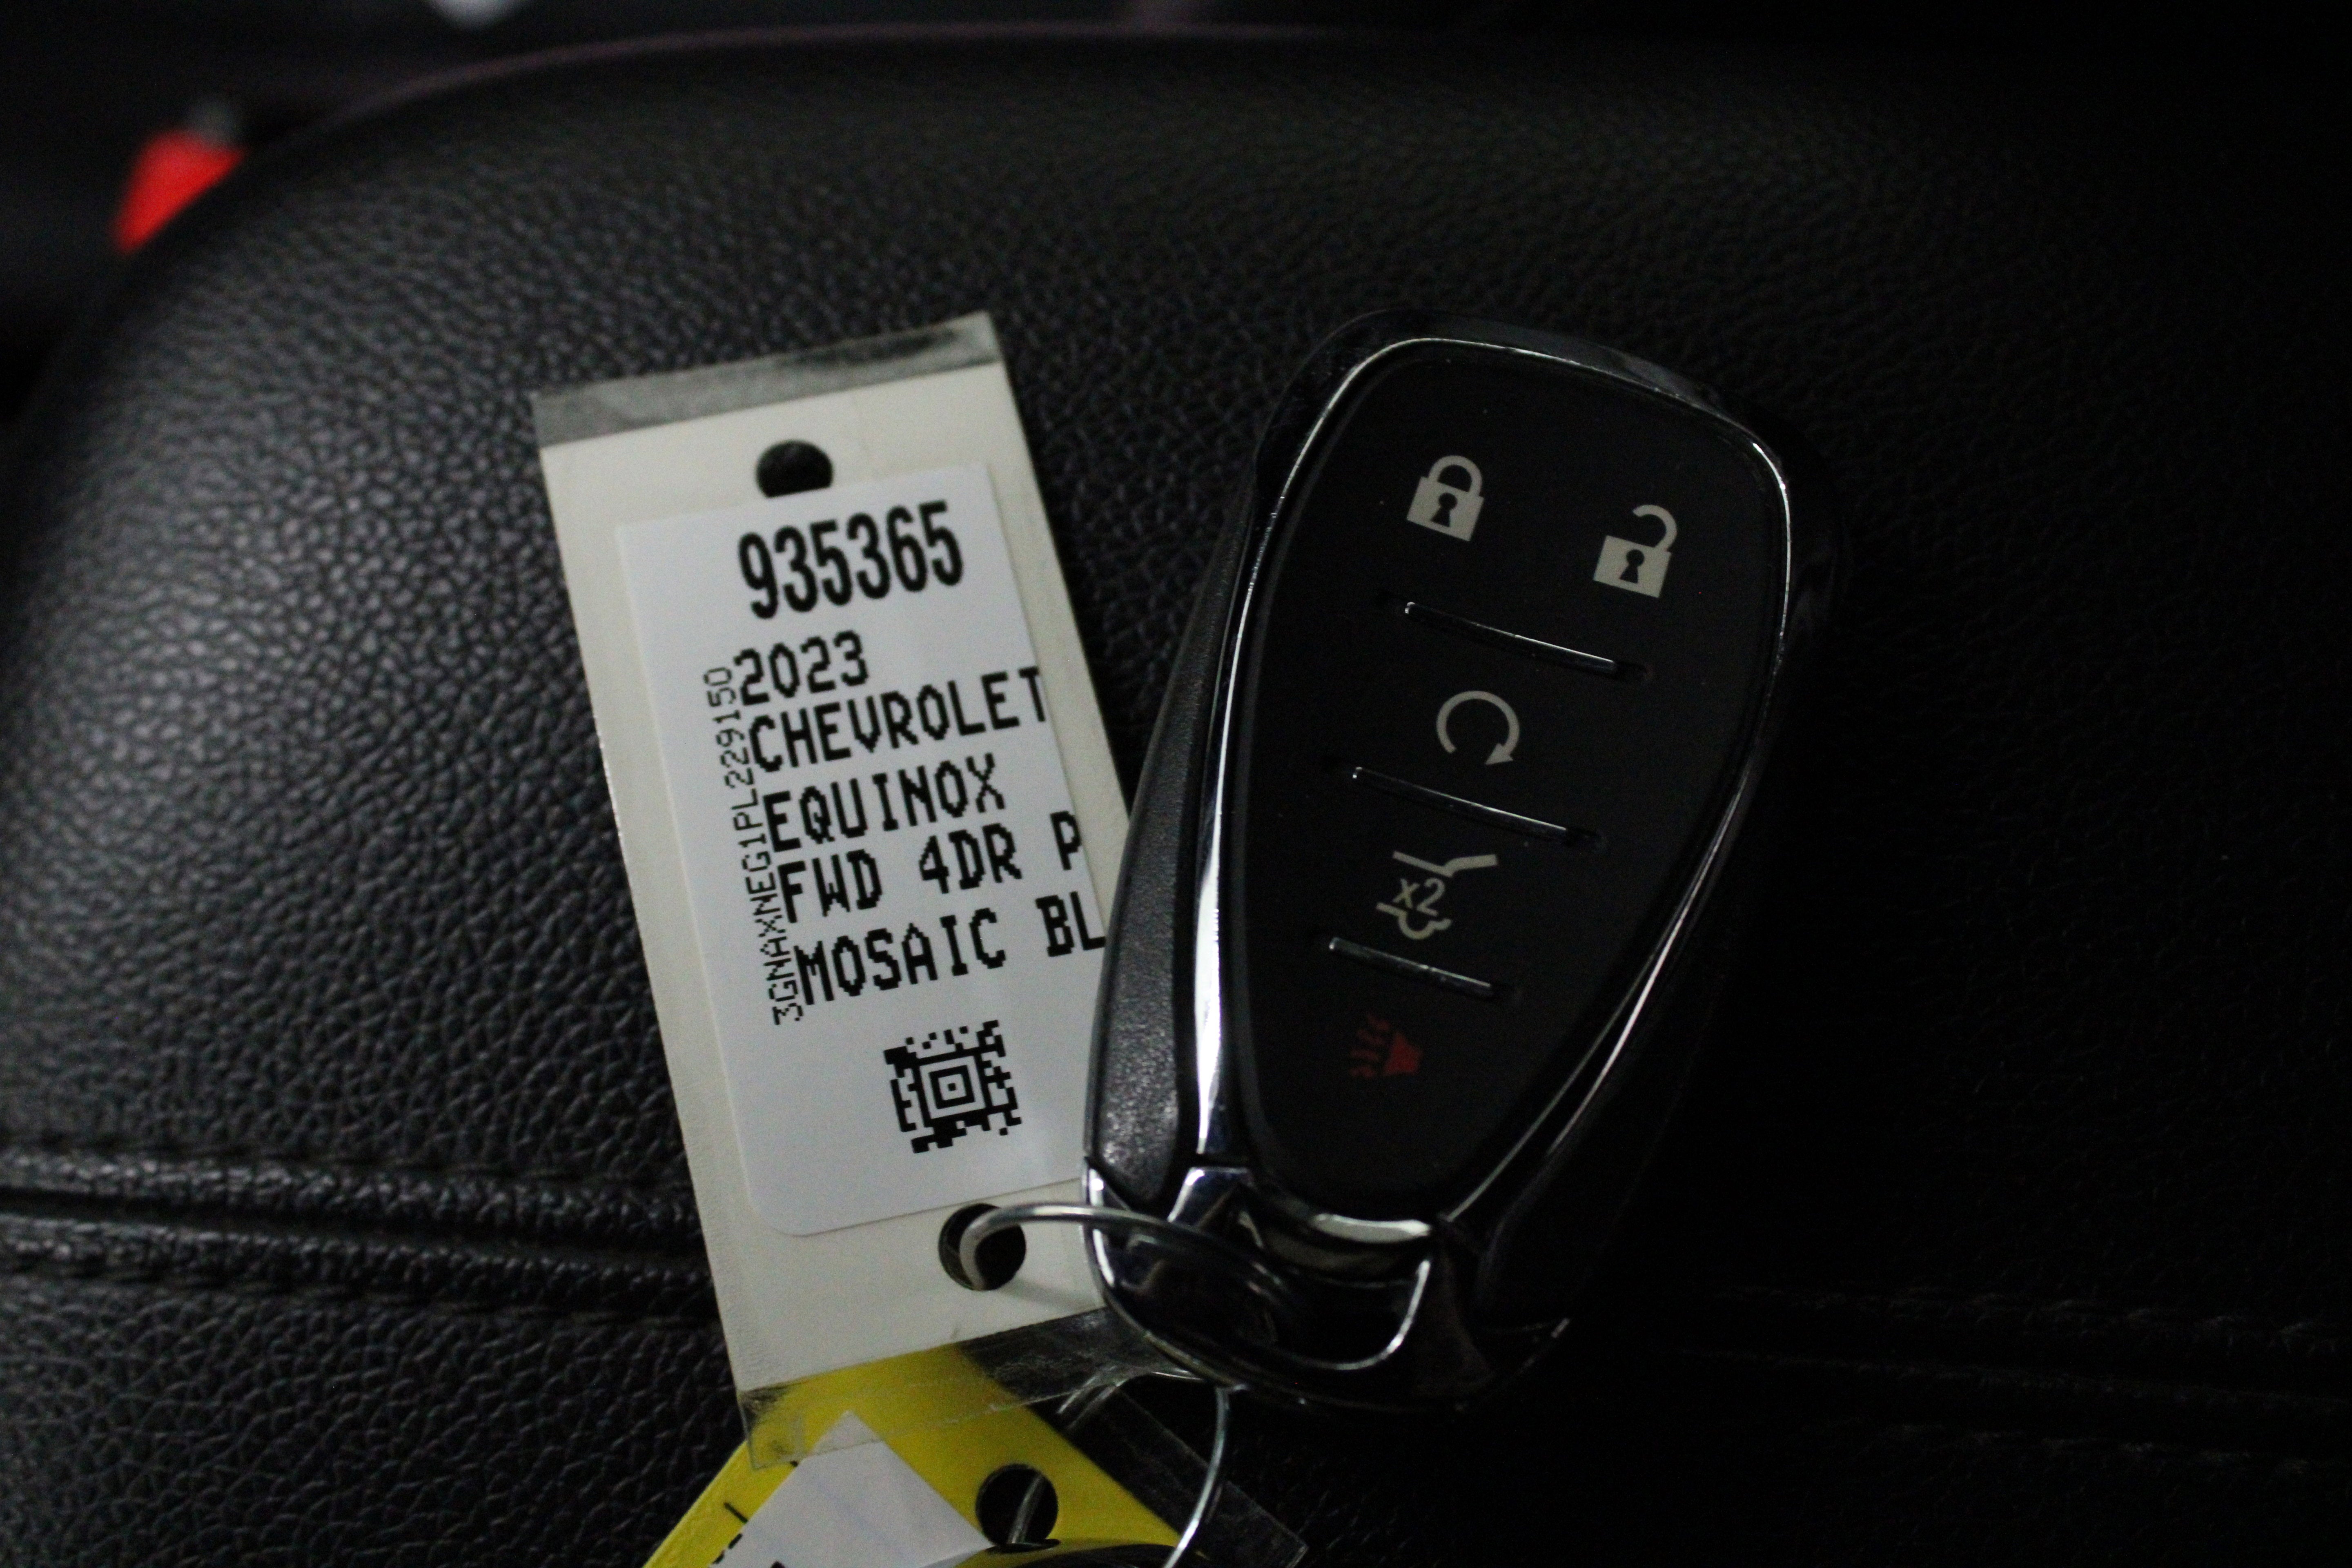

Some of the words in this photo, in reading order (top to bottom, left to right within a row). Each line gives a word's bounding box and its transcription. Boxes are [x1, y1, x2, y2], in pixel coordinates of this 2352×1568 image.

[737, 500, 964, 619] 935365
[734, 630, 869, 706] 2023
[748, 667, 1046, 773] CHEVROLET
[704, 667, 804, 1025] 3GNAXNEG1PL229150
[763, 753, 1005, 852] EQUINOX
[777, 849, 883, 924] FWD
[919, 823, 1022, 894] 4DR
[1050, 811, 1082, 871] P
[793, 908, 1006, 1005] MOSAIC
[1036, 891, 1106, 957] BL
